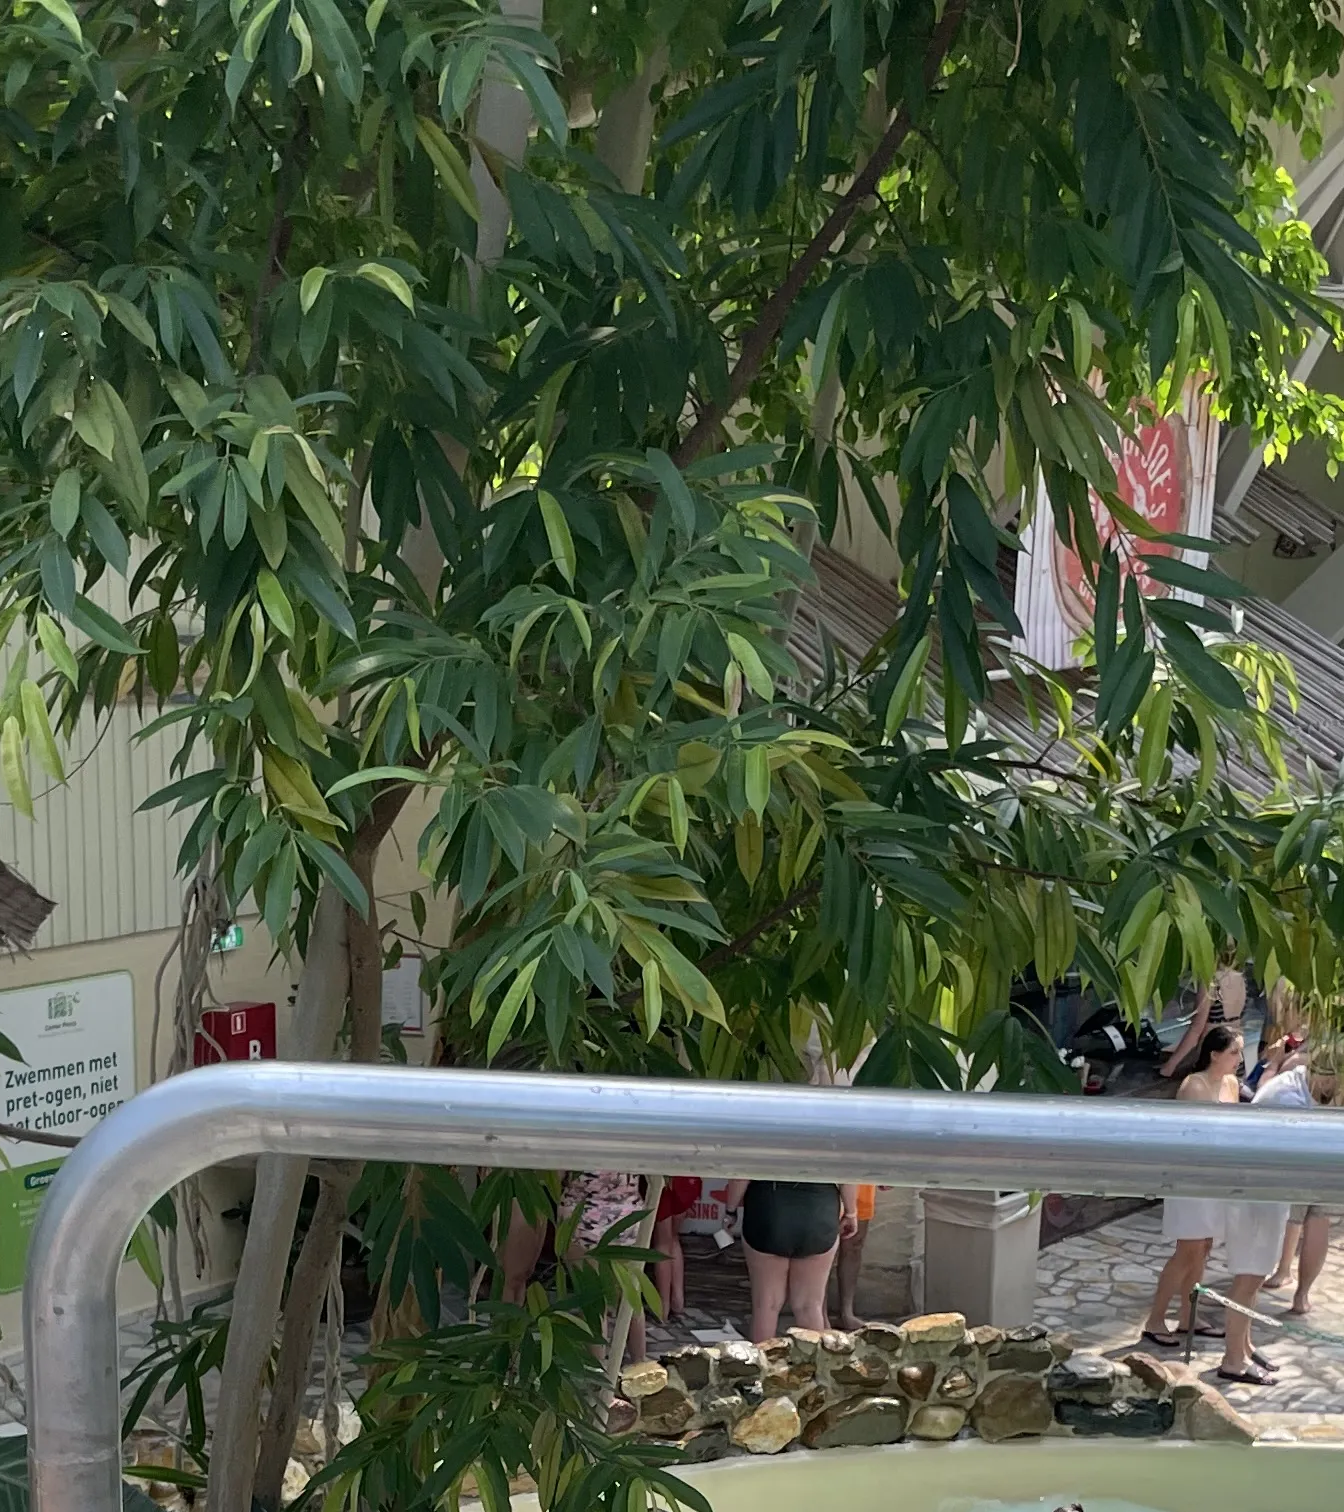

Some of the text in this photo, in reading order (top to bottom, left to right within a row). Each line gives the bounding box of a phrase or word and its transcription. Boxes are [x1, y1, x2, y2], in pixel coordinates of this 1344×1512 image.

[5, 1051, 118, 1089] Zwemmen met
[6, 1075, 118, 1117] pret-ogen, niet
